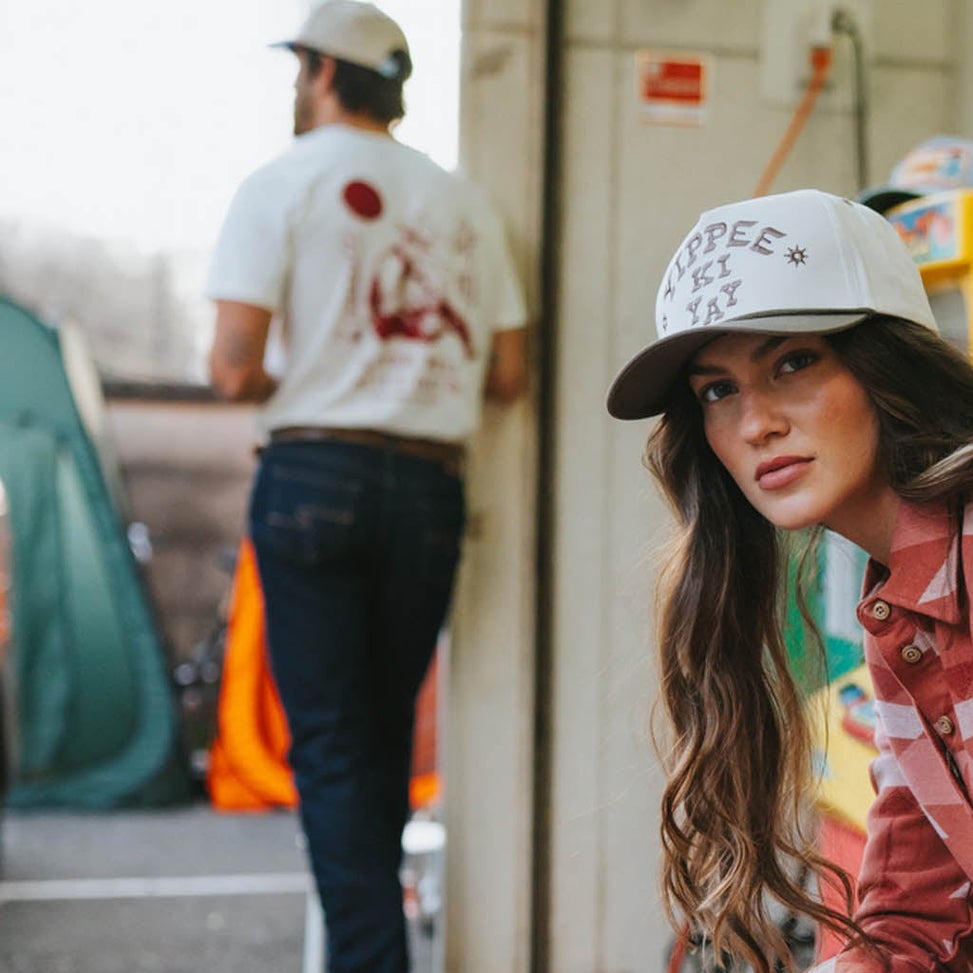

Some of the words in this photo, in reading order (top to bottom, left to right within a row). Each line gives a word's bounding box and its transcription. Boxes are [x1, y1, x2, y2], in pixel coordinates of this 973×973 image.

[664, 220, 787, 302] YIPPEE
[692, 253, 731, 293] KI
[686, 280, 742, 326] YAY
